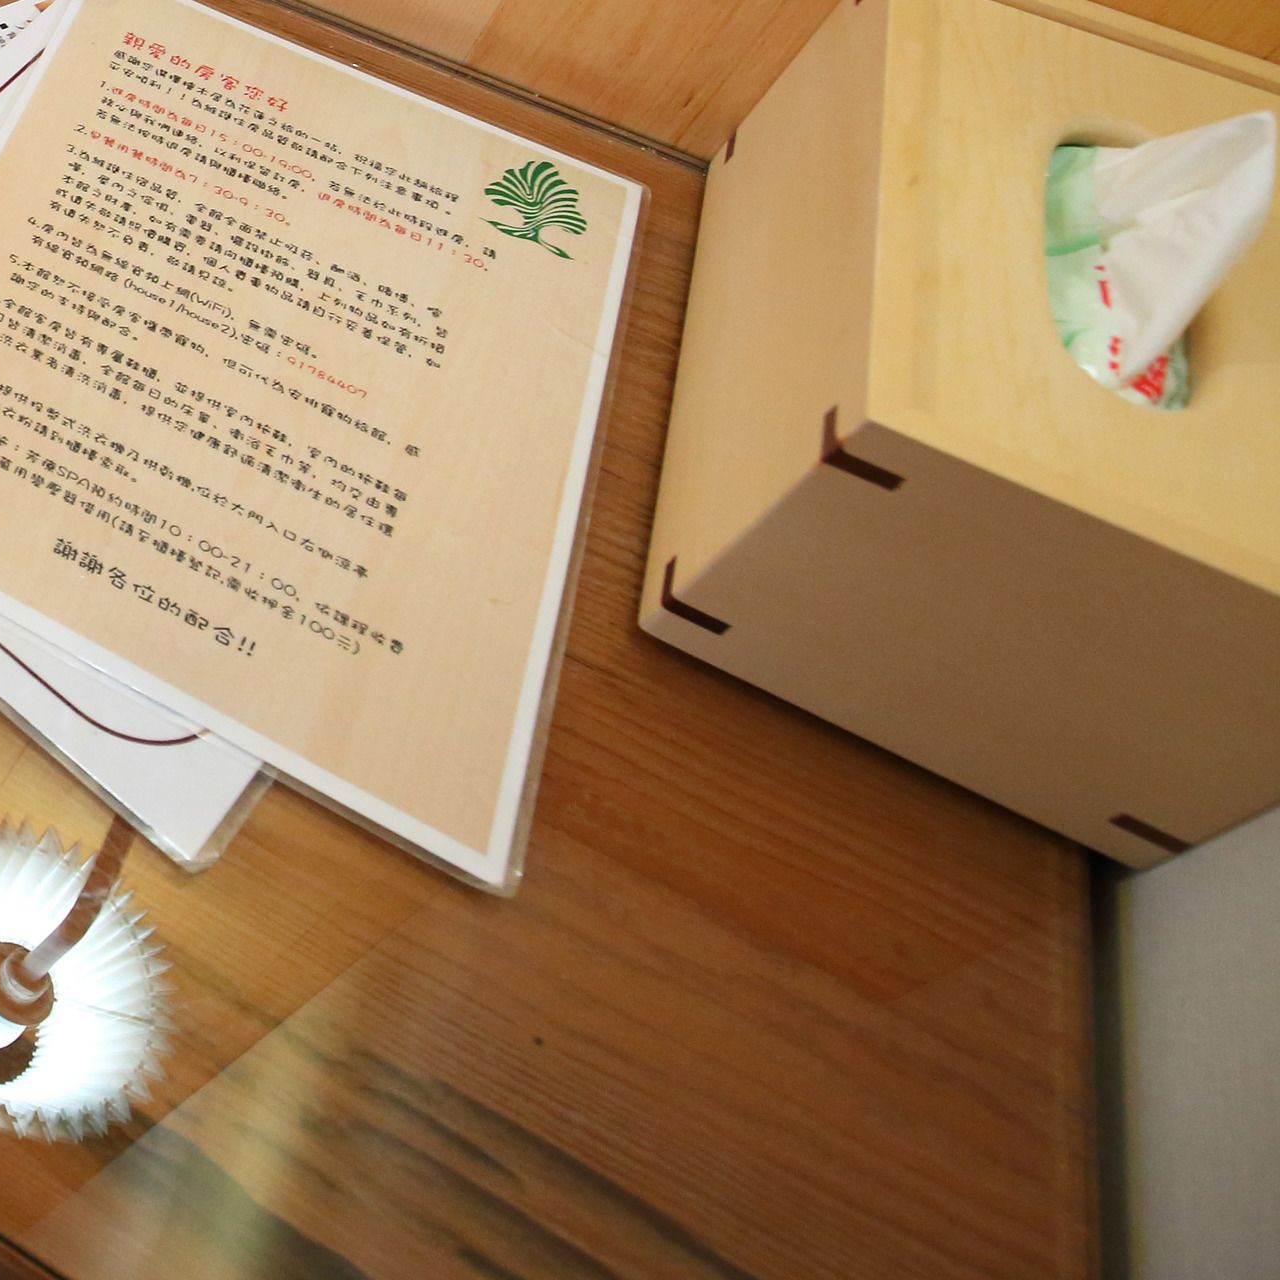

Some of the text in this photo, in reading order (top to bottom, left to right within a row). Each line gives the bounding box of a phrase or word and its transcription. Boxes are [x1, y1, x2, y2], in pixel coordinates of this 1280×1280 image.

[120, 30, 291, 115] 親愛的房客您好
[50, 534, 259, 663] 謝謝各位的配合!!
